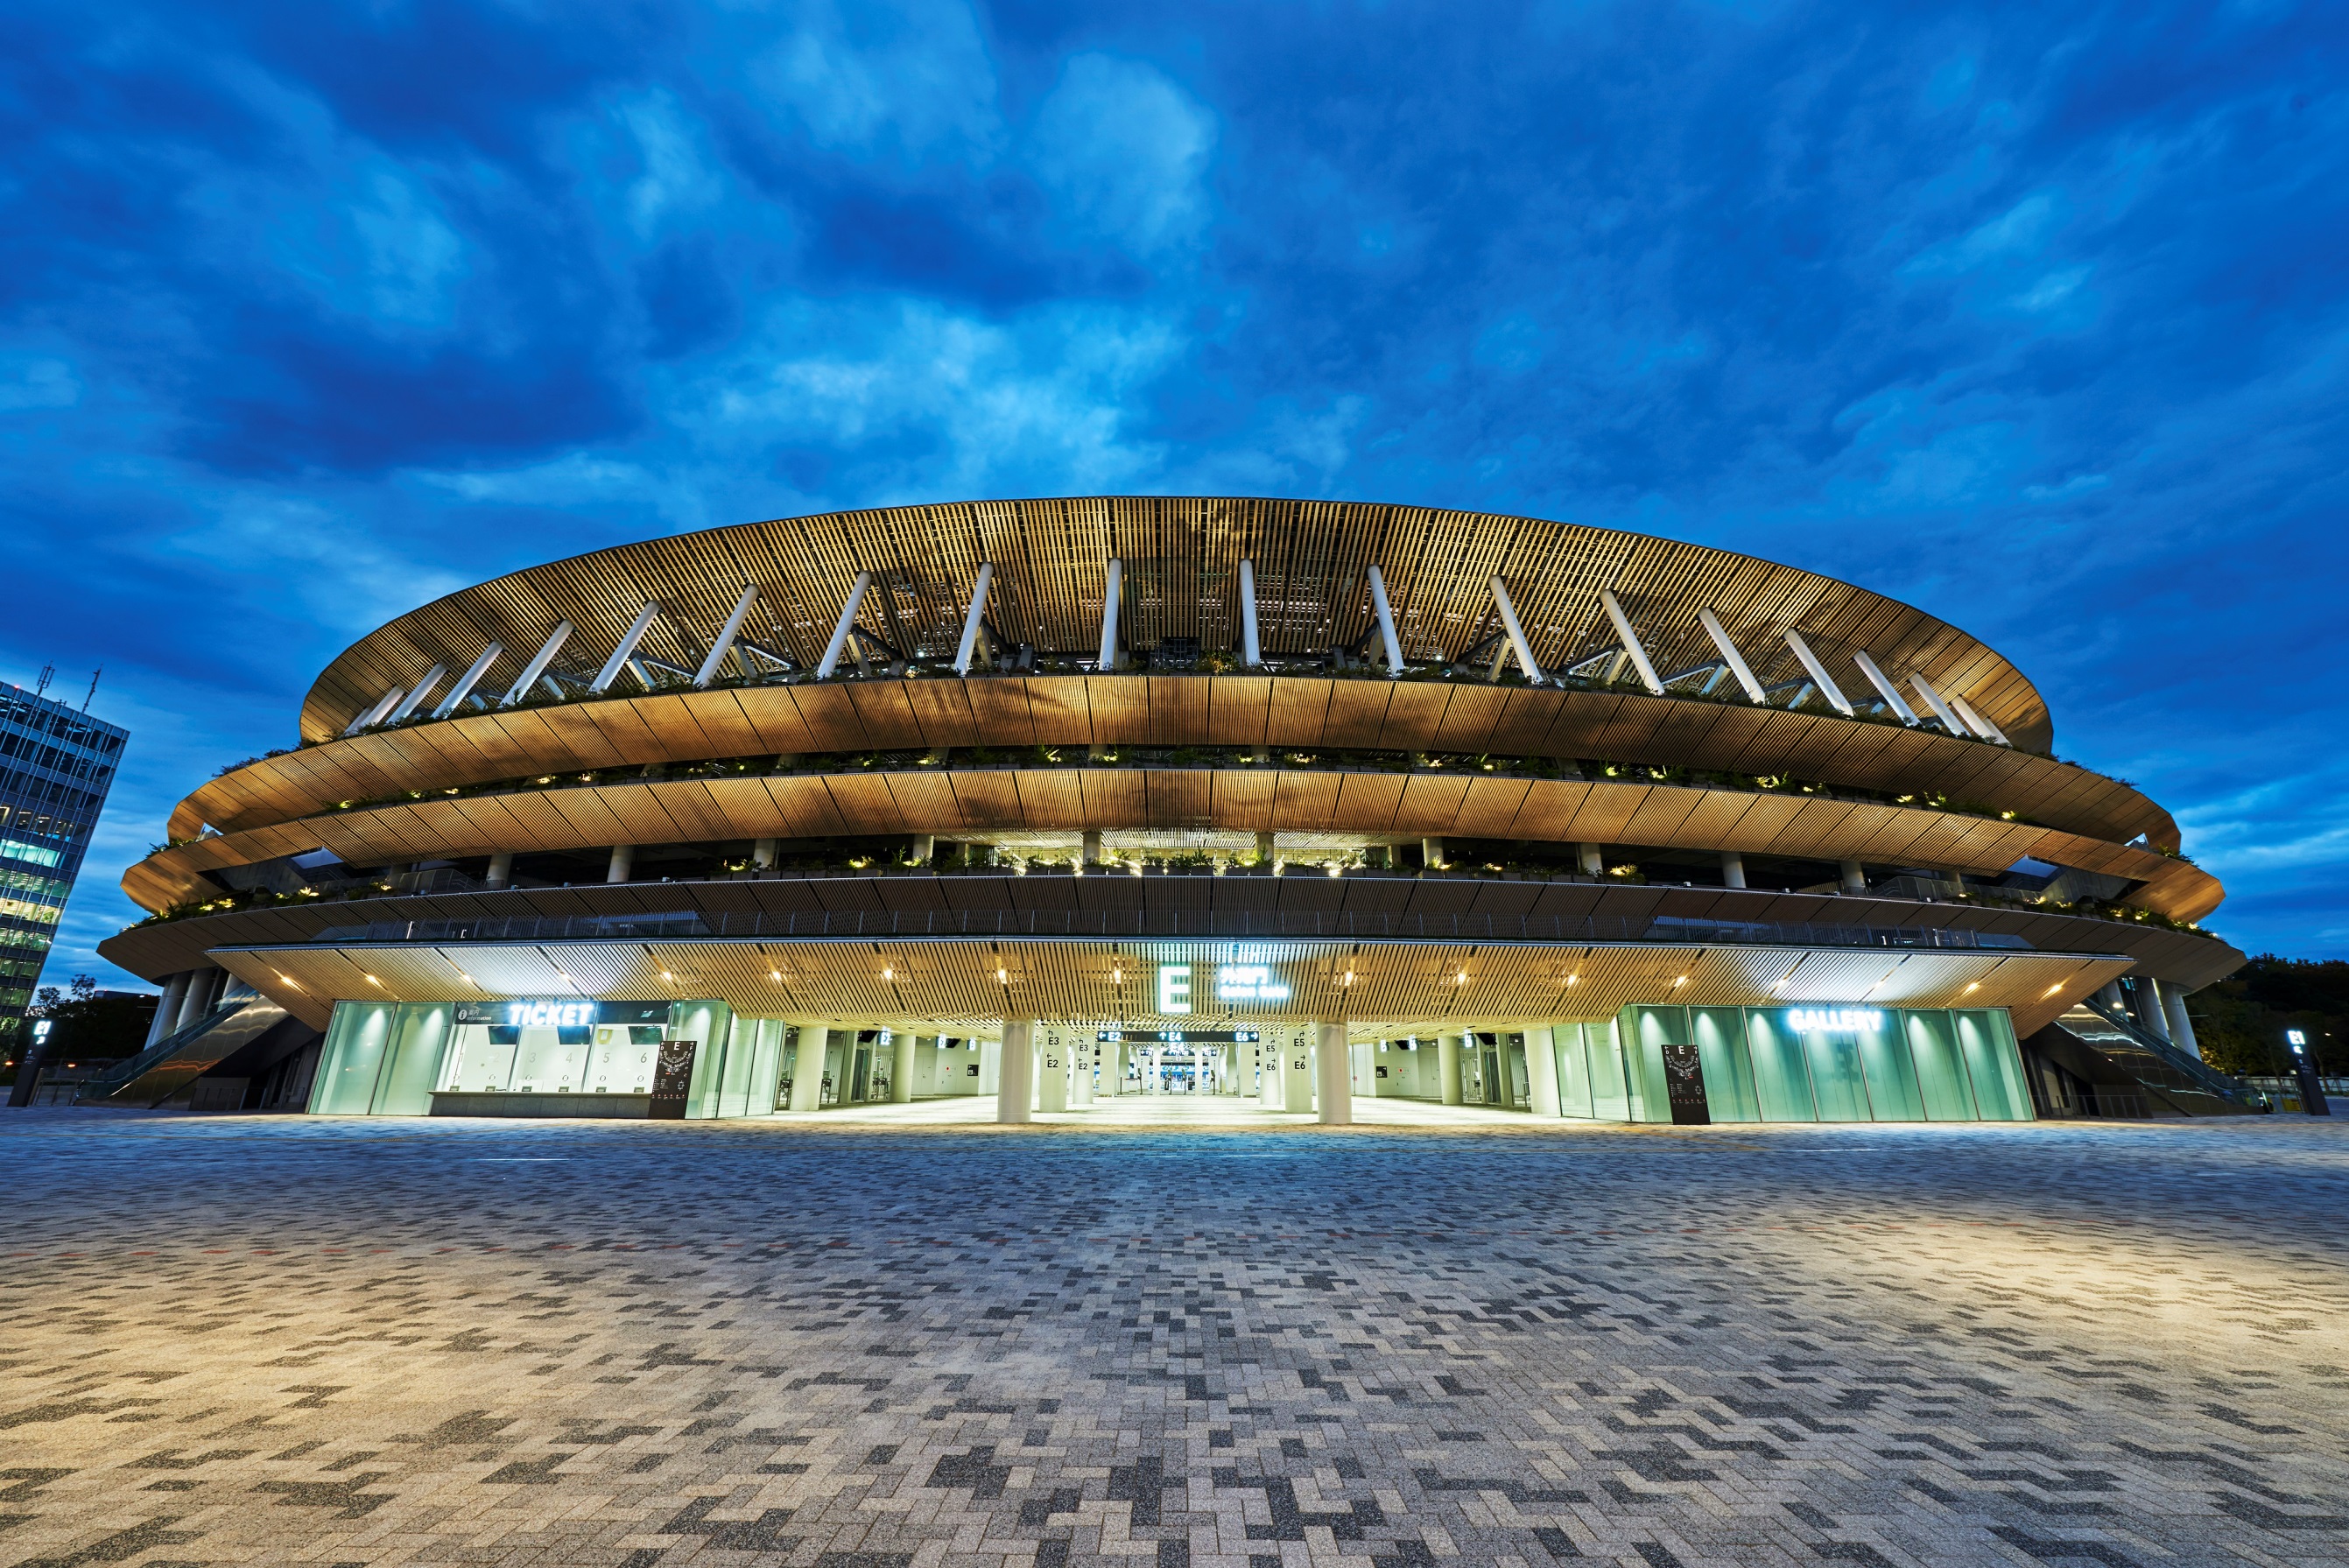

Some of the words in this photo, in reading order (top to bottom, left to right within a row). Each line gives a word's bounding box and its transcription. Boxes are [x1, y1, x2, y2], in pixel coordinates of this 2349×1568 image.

[1160, 967, 1191, 1013] E
[510, 1004, 594, 1025] TICKET
[1789, 1009, 1881, 1031] GALLERY
[34, 1020, 51, 1035] E1
[1048, 1037, 1059, 1045] E3
[1108, 1031, 1121, 1042] E2
[1169, 1031, 1181, 1042] E4
[1235, 1031, 1249, 1042] E6
[673, 1041, 680, 1051] E
[1293, 1038, 1305, 1047] E5
[1677, 1045, 1685, 1055] E
[529, 1052, 537, 1063] 3
[566, 1052, 573, 1063] 4
[602, 1052, 610, 1063] 5
[640, 1052, 648, 1064] 6
[1047, 1059, 1058, 1068] E2
[1294, 1061, 1306, 1070] E6
